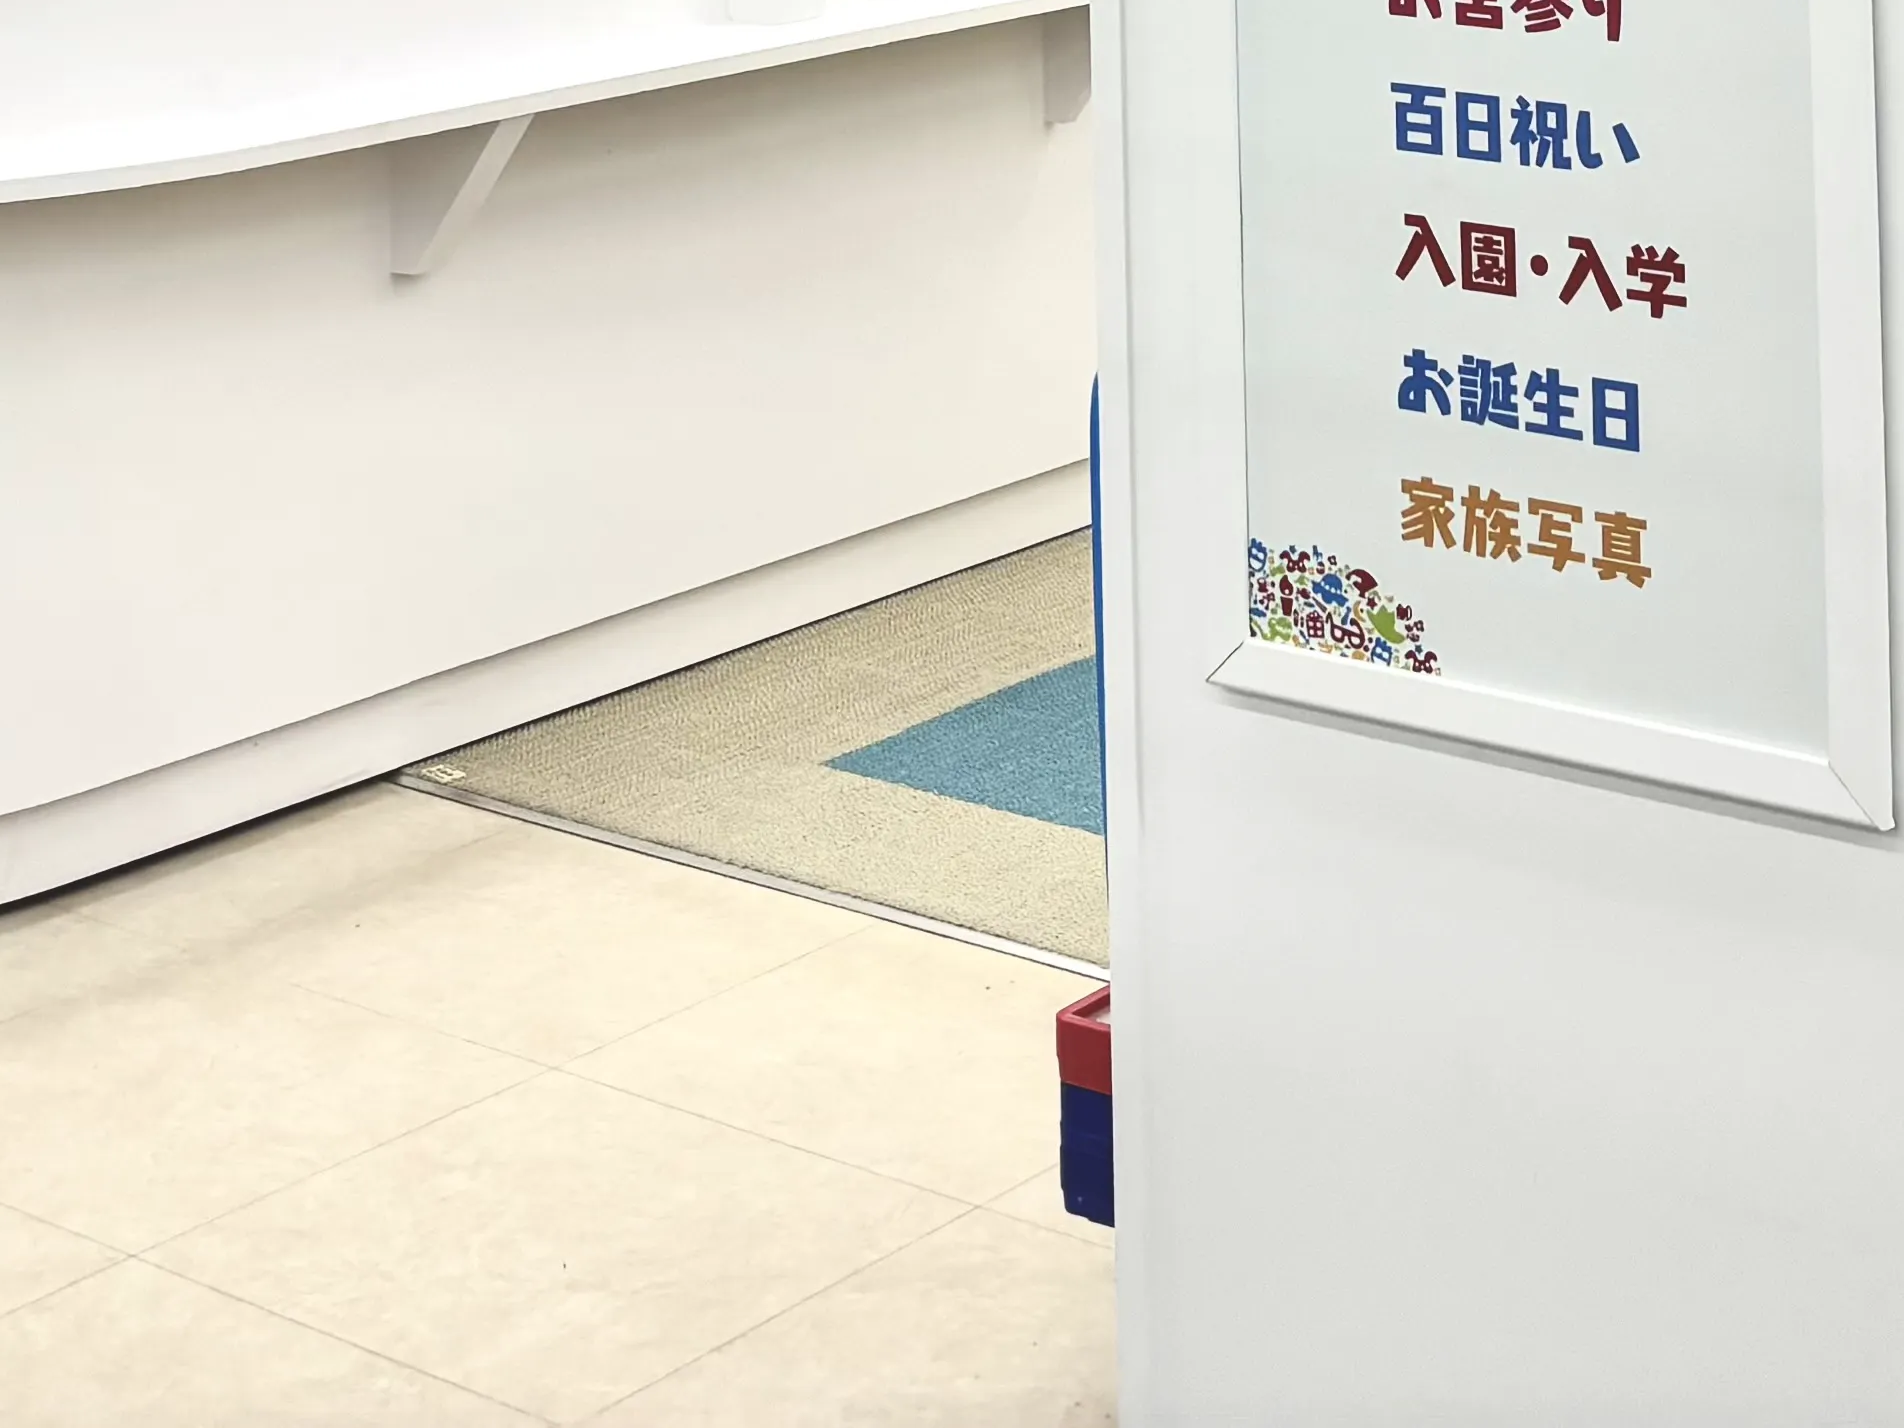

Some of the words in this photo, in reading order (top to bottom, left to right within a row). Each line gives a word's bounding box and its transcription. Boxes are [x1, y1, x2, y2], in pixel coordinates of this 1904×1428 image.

[1389, 80, 1641, 171] 百日祝い
[1395, 214, 1689, 319] 入園・入学
[1397, 347, 1639, 453] お誕生日
[1399, 476, 1653, 590] 家族写真
